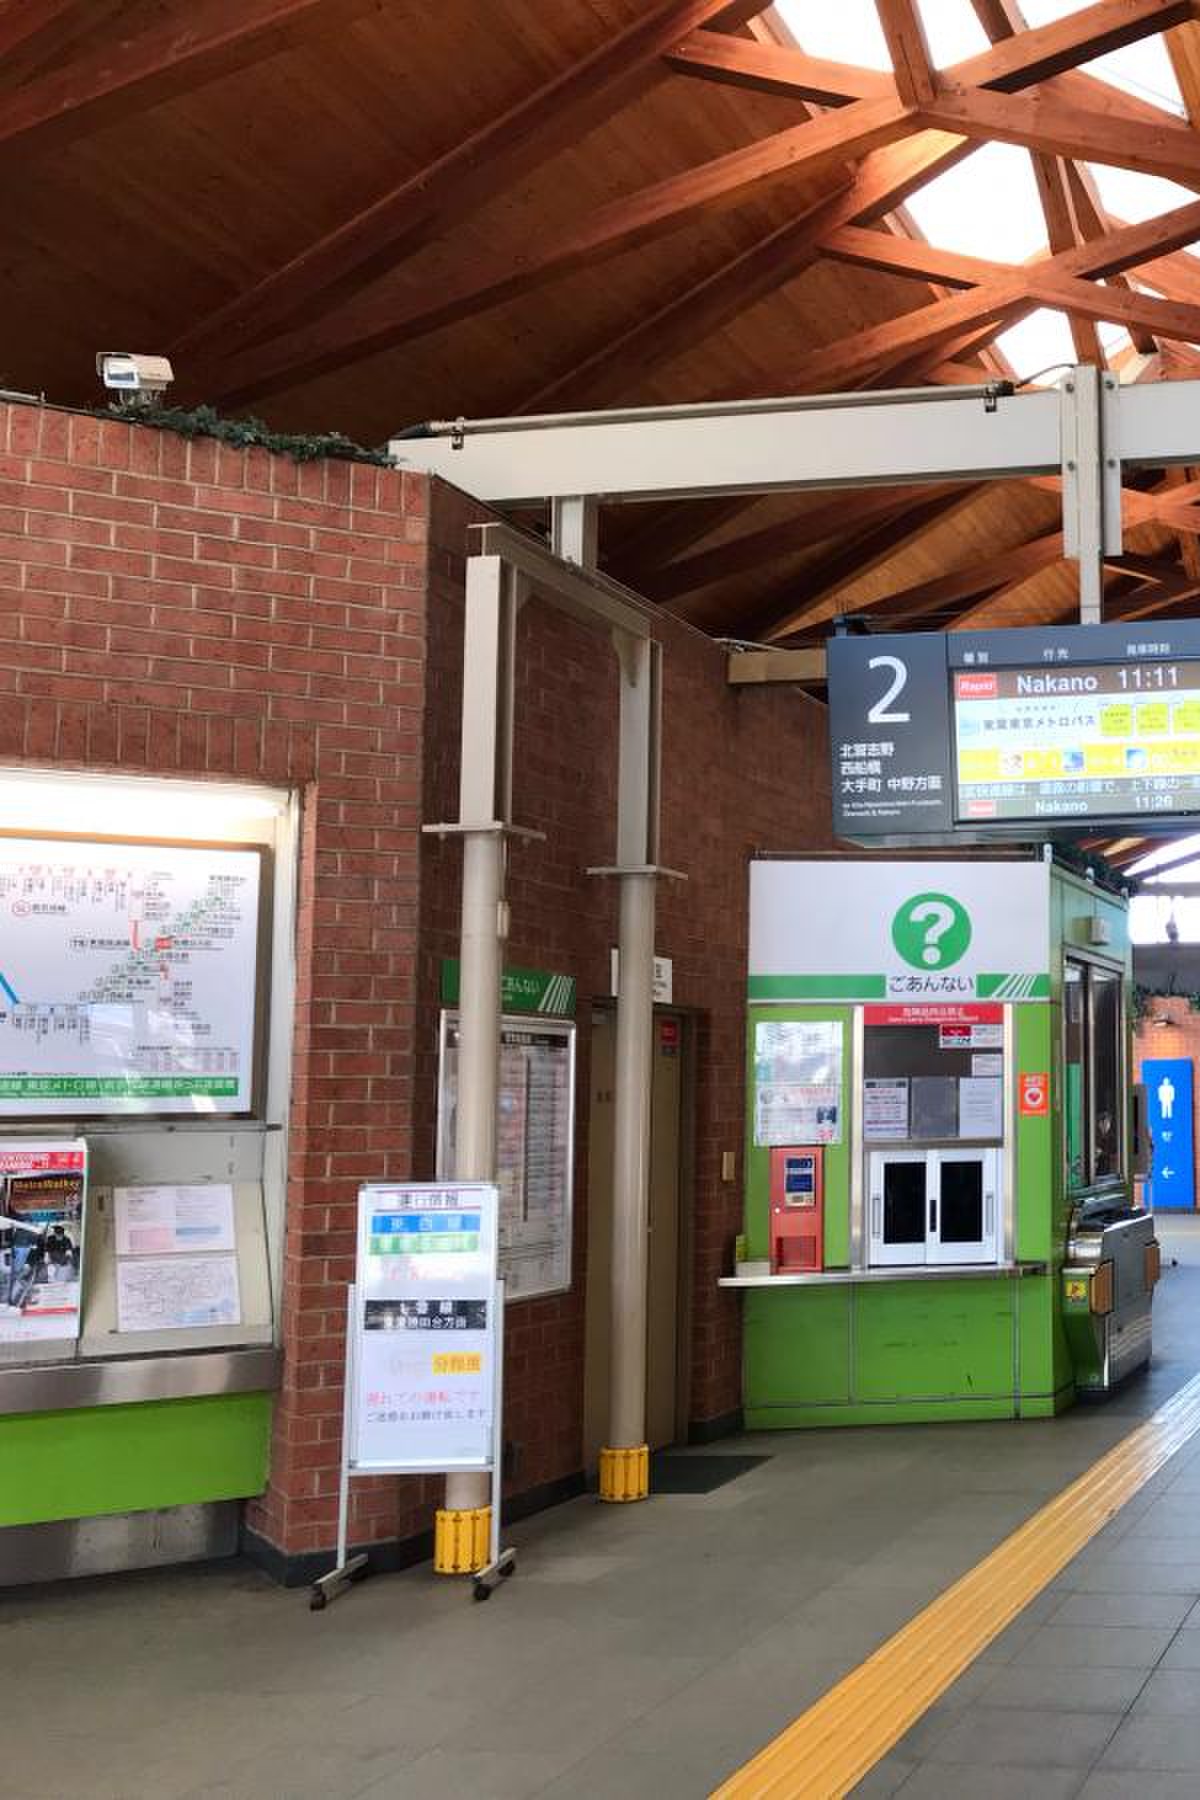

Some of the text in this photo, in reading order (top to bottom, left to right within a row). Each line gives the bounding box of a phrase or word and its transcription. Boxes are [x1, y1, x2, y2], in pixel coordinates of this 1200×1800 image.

[867, 655, 911, 723] 2
[1017, 674, 1098, 694] Nakano
[1119, 667, 1179, 688] 11:11
[840, 760, 881, 775] 西船橋
[841, 777, 881, 793] 大手町
[886, 775, 943, 791] 中野方面
[1036, 801, 1089, 814] Nakano
[890, 975, 975, 993] ごあんない
